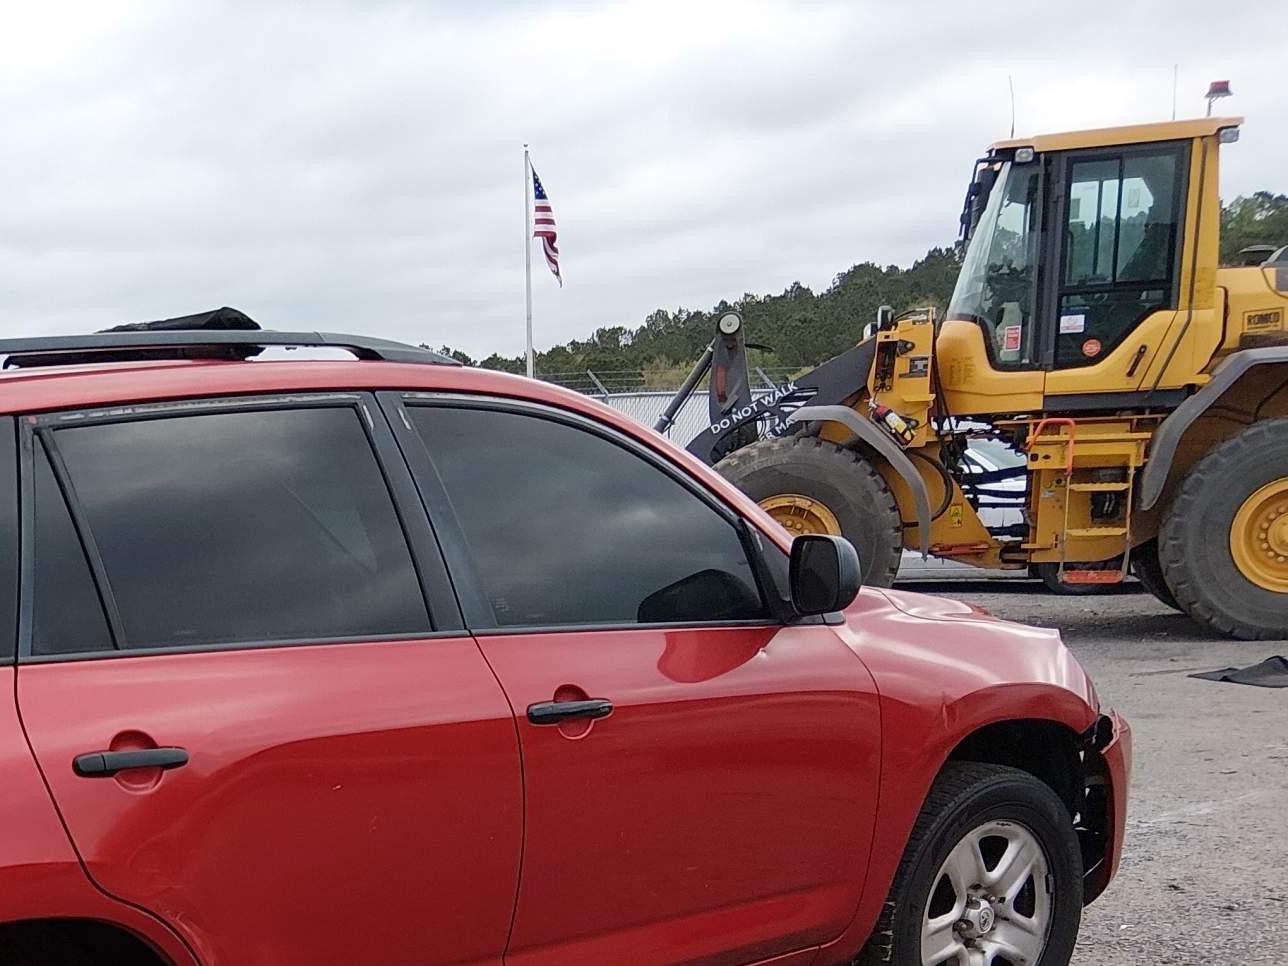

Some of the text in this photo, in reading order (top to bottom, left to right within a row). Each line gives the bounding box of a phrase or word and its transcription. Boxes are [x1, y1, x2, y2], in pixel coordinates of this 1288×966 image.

[711, 381, 798, 434] DO NOT WALK
